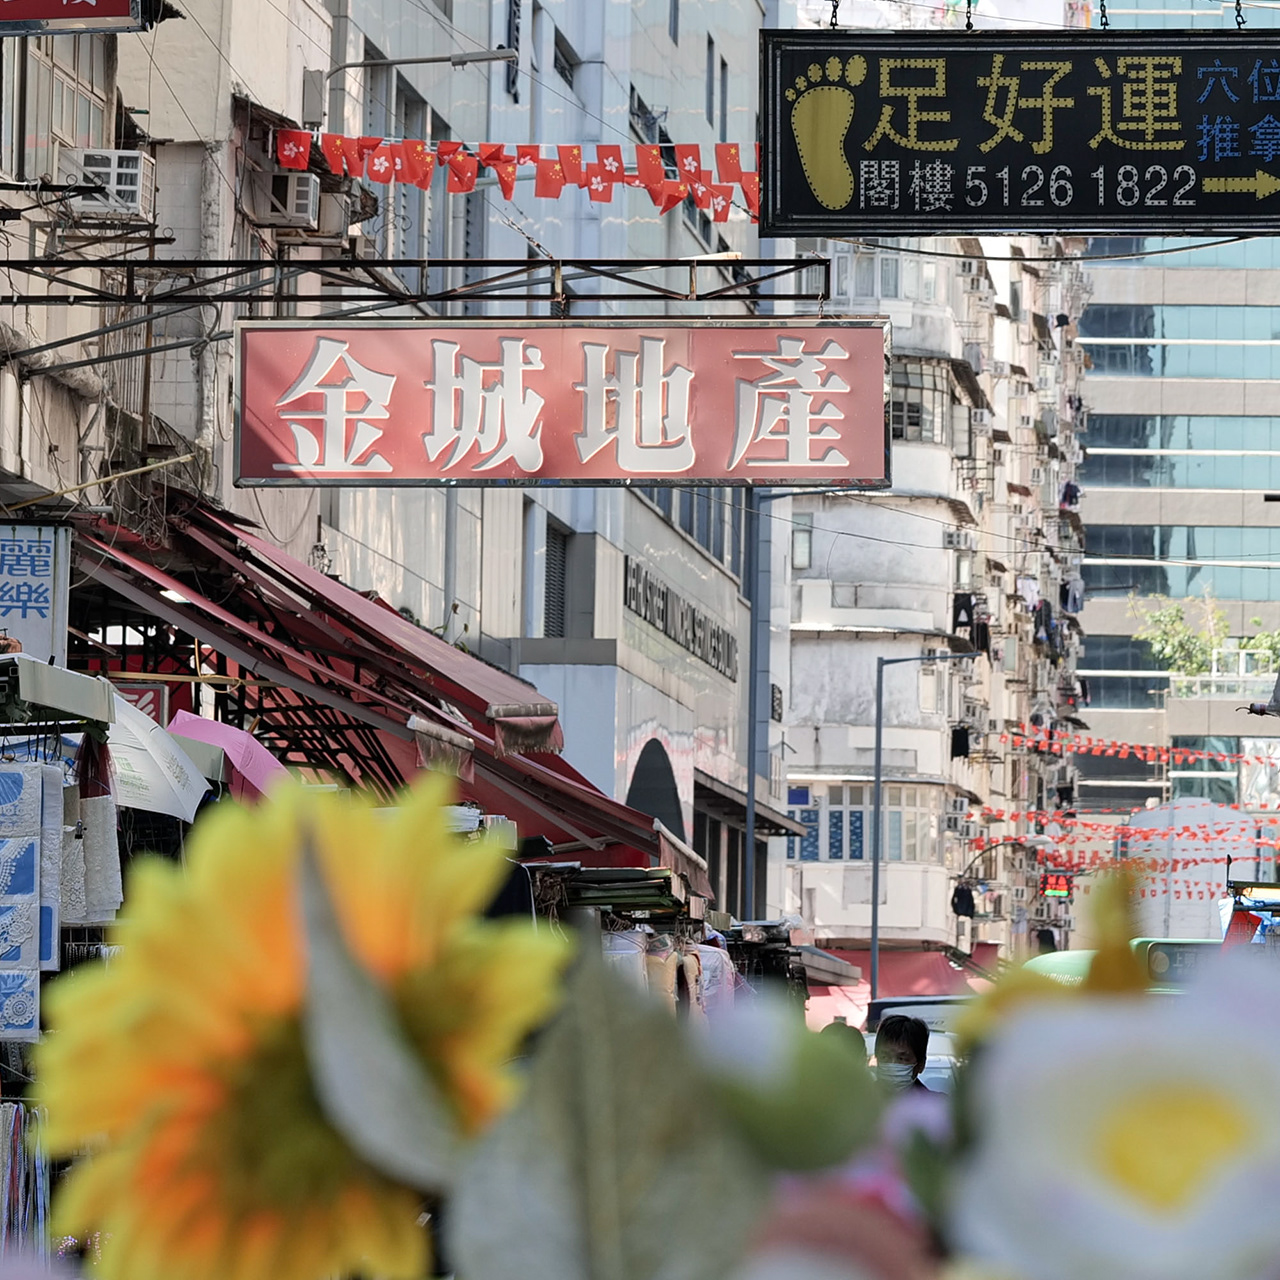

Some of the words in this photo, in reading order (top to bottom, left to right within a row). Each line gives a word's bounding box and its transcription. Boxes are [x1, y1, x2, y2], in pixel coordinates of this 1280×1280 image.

[862, 53, 1187, 155] 足好運
[858, 158, 956, 212] 閣樓
[963, 164, 1074, 207] 5126
[1090, 164, 1197, 207] 1822
[273, 335, 851, 474] 金城地產
